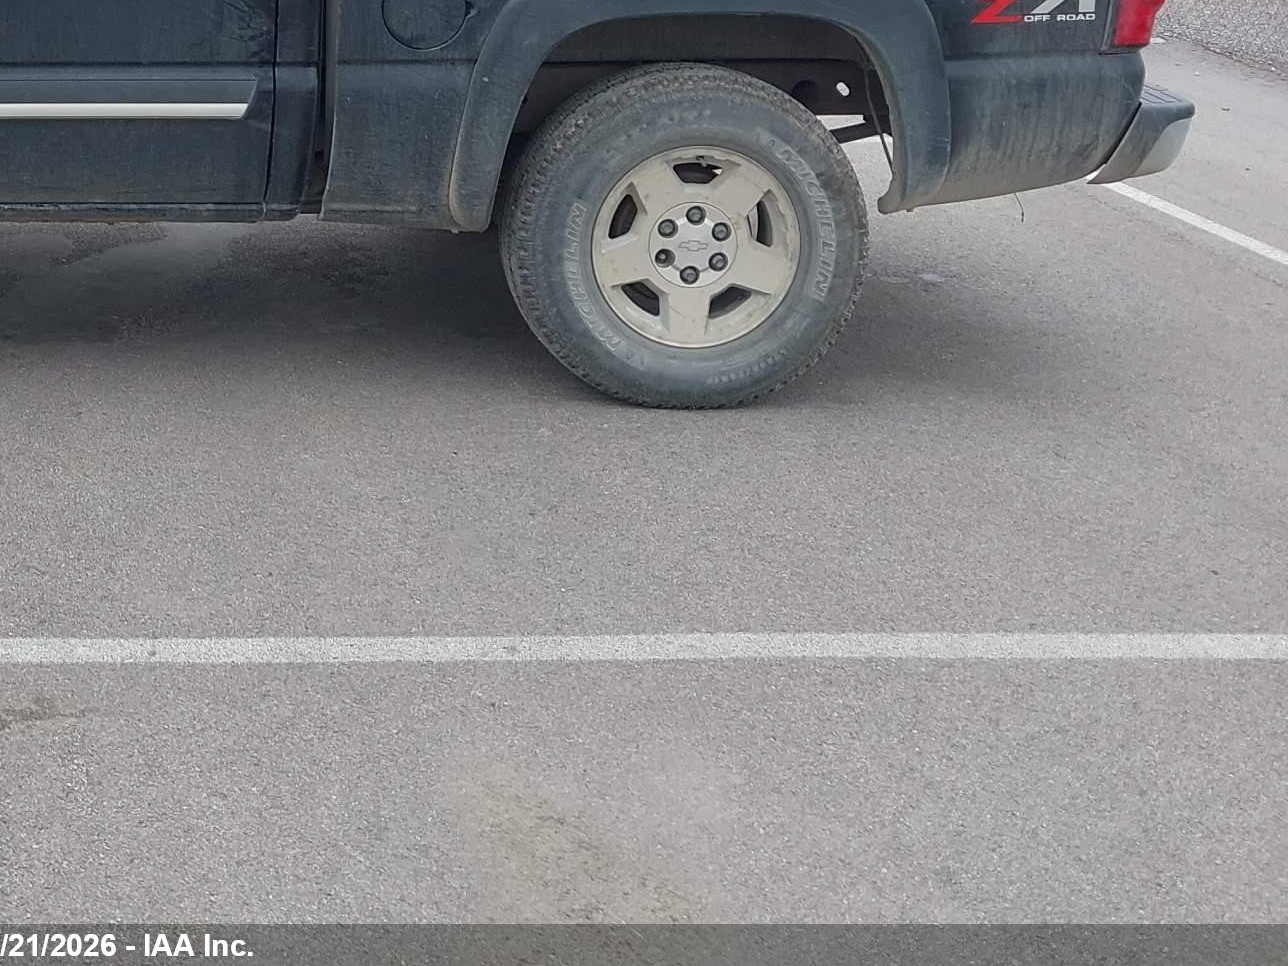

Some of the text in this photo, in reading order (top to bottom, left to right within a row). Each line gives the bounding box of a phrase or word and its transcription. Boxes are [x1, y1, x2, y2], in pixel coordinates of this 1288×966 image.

[1023, 13, 1096, 22] OFF ROAD
[776, 146, 836, 302] MICHELIN
